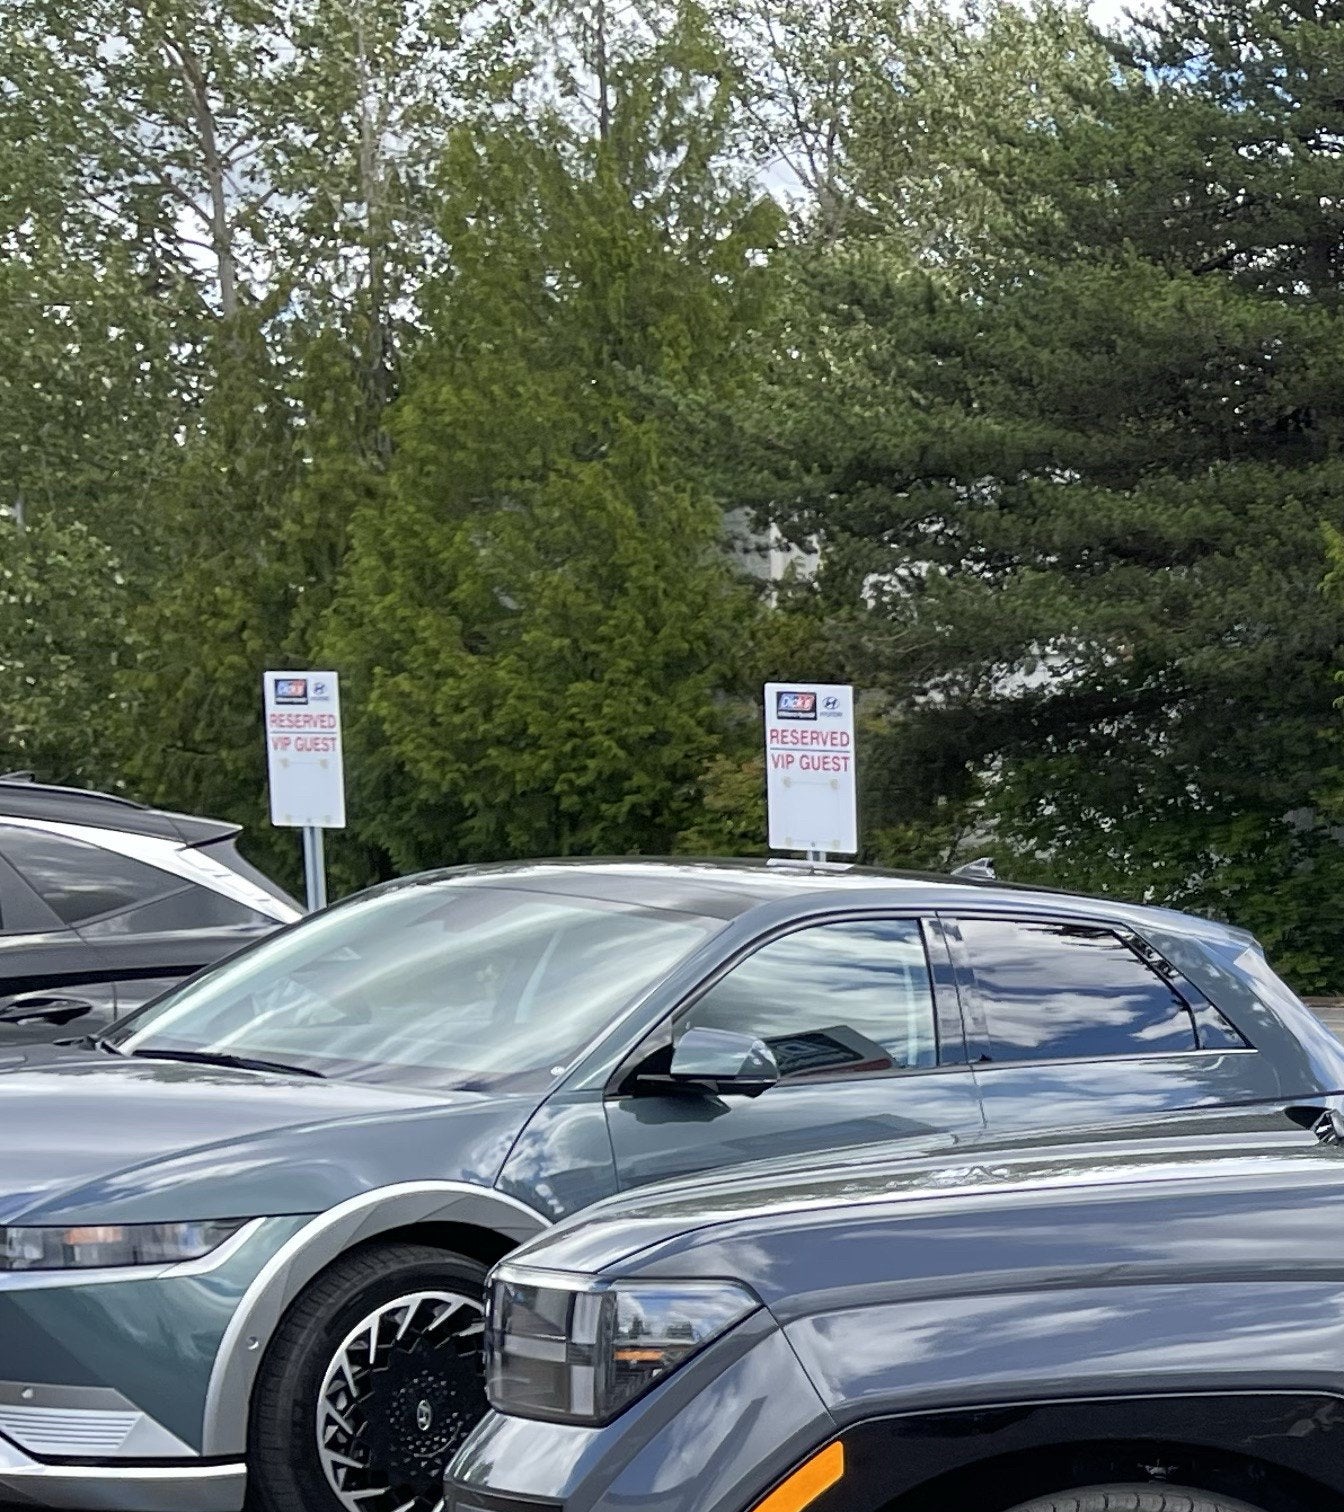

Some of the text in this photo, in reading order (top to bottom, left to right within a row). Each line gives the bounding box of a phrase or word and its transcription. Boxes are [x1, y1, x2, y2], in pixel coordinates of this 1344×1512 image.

[270, 713, 337, 729] RESERVED
[271, 737, 337, 752] VIP GUEST
[770, 729, 850, 747] RESERVED
[771, 754, 850, 772] VIP GUEST
